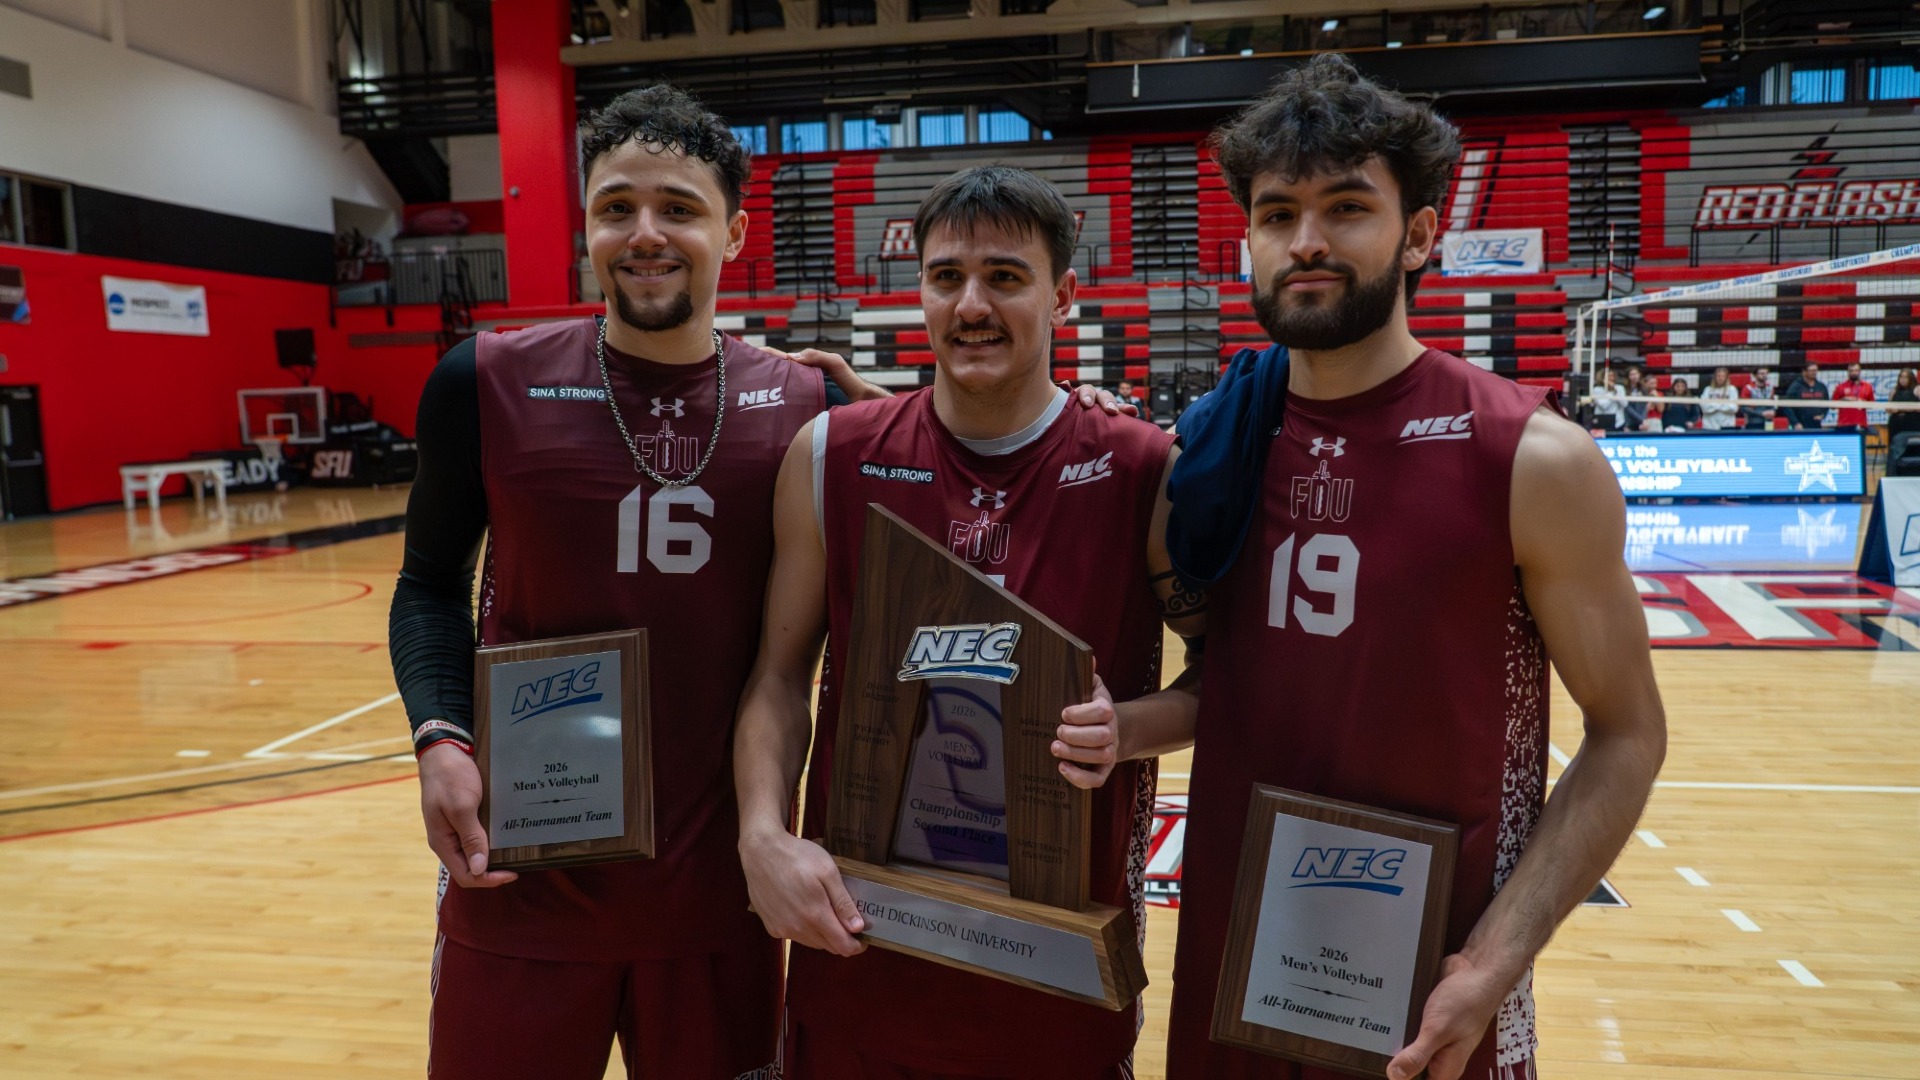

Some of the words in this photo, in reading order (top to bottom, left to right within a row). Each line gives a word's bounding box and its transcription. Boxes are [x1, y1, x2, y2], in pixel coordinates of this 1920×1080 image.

[1699, 186, 1788, 224] RED
[1456, 237, 1529, 262] NEC
[530, 388, 555, 398] SINA
[559, 388, 605, 399] STRONG
[738, 387, 784, 407] NEC
[1400, 411, 1475, 438] NEC
[311, 450, 353, 478] SFU
[634, 433, 699, 476] FDU
[1617, 445, 1632, 458] to
[1634, 445, 1658, 458] the
[862, 464, 887, 478] SINA
[889, 468, 933, 482] STRONG
[1058, 451, 1114, 484] NEC
[1625, 458, 1753, 474] VOLLEYBALL
[1290, 475, 1354, 523] FDU
[616, 483, 715, 574] 16
[948, 520, 1010, 565] FDU
[1267, 531, 1361, 638] 19
[907, 627, 1016, 664] NEC
[511, 661, 601, 716] NEC
[950, 704, 977, 718] 2026
[928, 750, 990, 771] VOLLEYBALL
[944, 740, 976, 756] MEN'S
[543, 762, 569, 774] 2026
[513, 779, 545, 792] Men's
[548, 773, 600, 790] Volleyball
[500, 815, 583, 831] All-Tournament
[585, 810, 613, 823] Team
[910, 797, 1002, 829] Championship
[912, 817, 958, 838] Second
[962, 827, 997, 846] Place
[1291, 847, 1407, 880] NEC
[856, 900, 885, 919] EIGH
[887, 908, 957, 938] DICKINSON
[960, 929, 1037, 959] UNIVERSITY
[1319, 946, 1349, 964] 2026
[1280, 954, 1319, 975] Men's
[1322, 963, 1384, 990] Volleyball
[1258, 993, 1355, 1027] All-Tournament
[1357, 1016, 1392, 1036] Team
